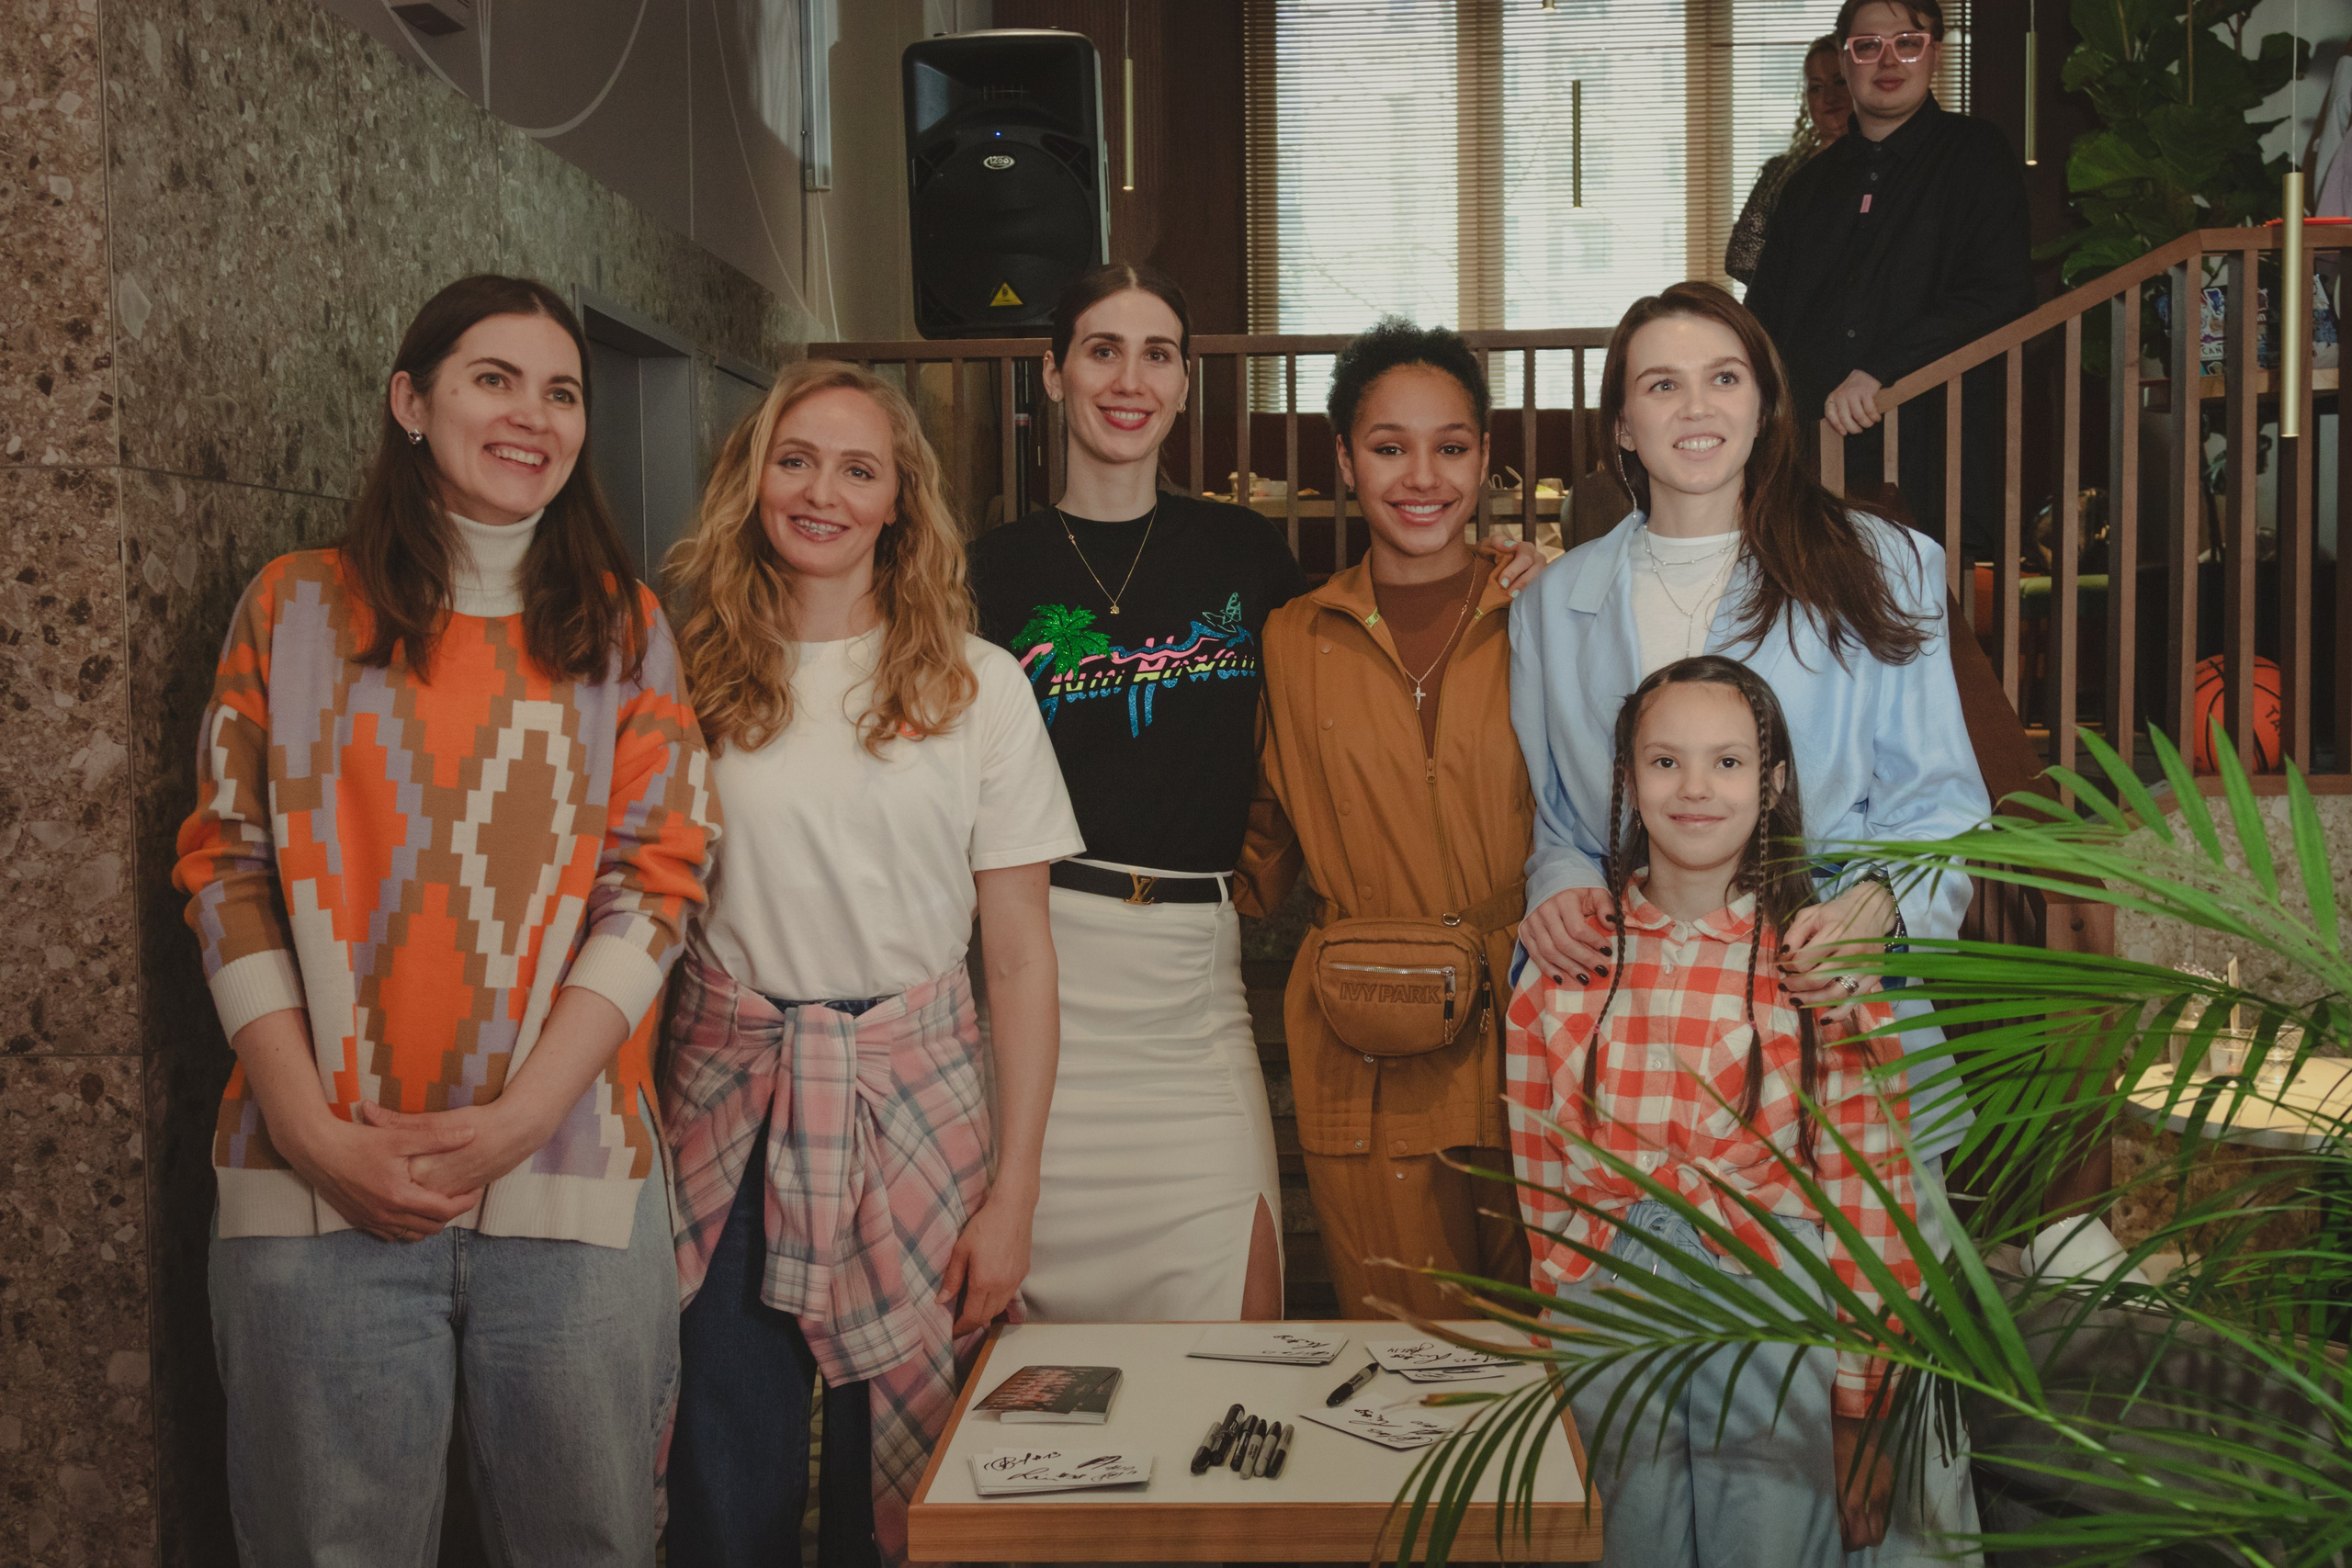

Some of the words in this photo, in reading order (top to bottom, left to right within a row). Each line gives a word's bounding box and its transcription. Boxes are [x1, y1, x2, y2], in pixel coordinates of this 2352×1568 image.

[989, 155, 1010, 164] 1200
[1340, 982, 1379, 1003] IVY
[1378, 982, 1442, 1004] PARK
